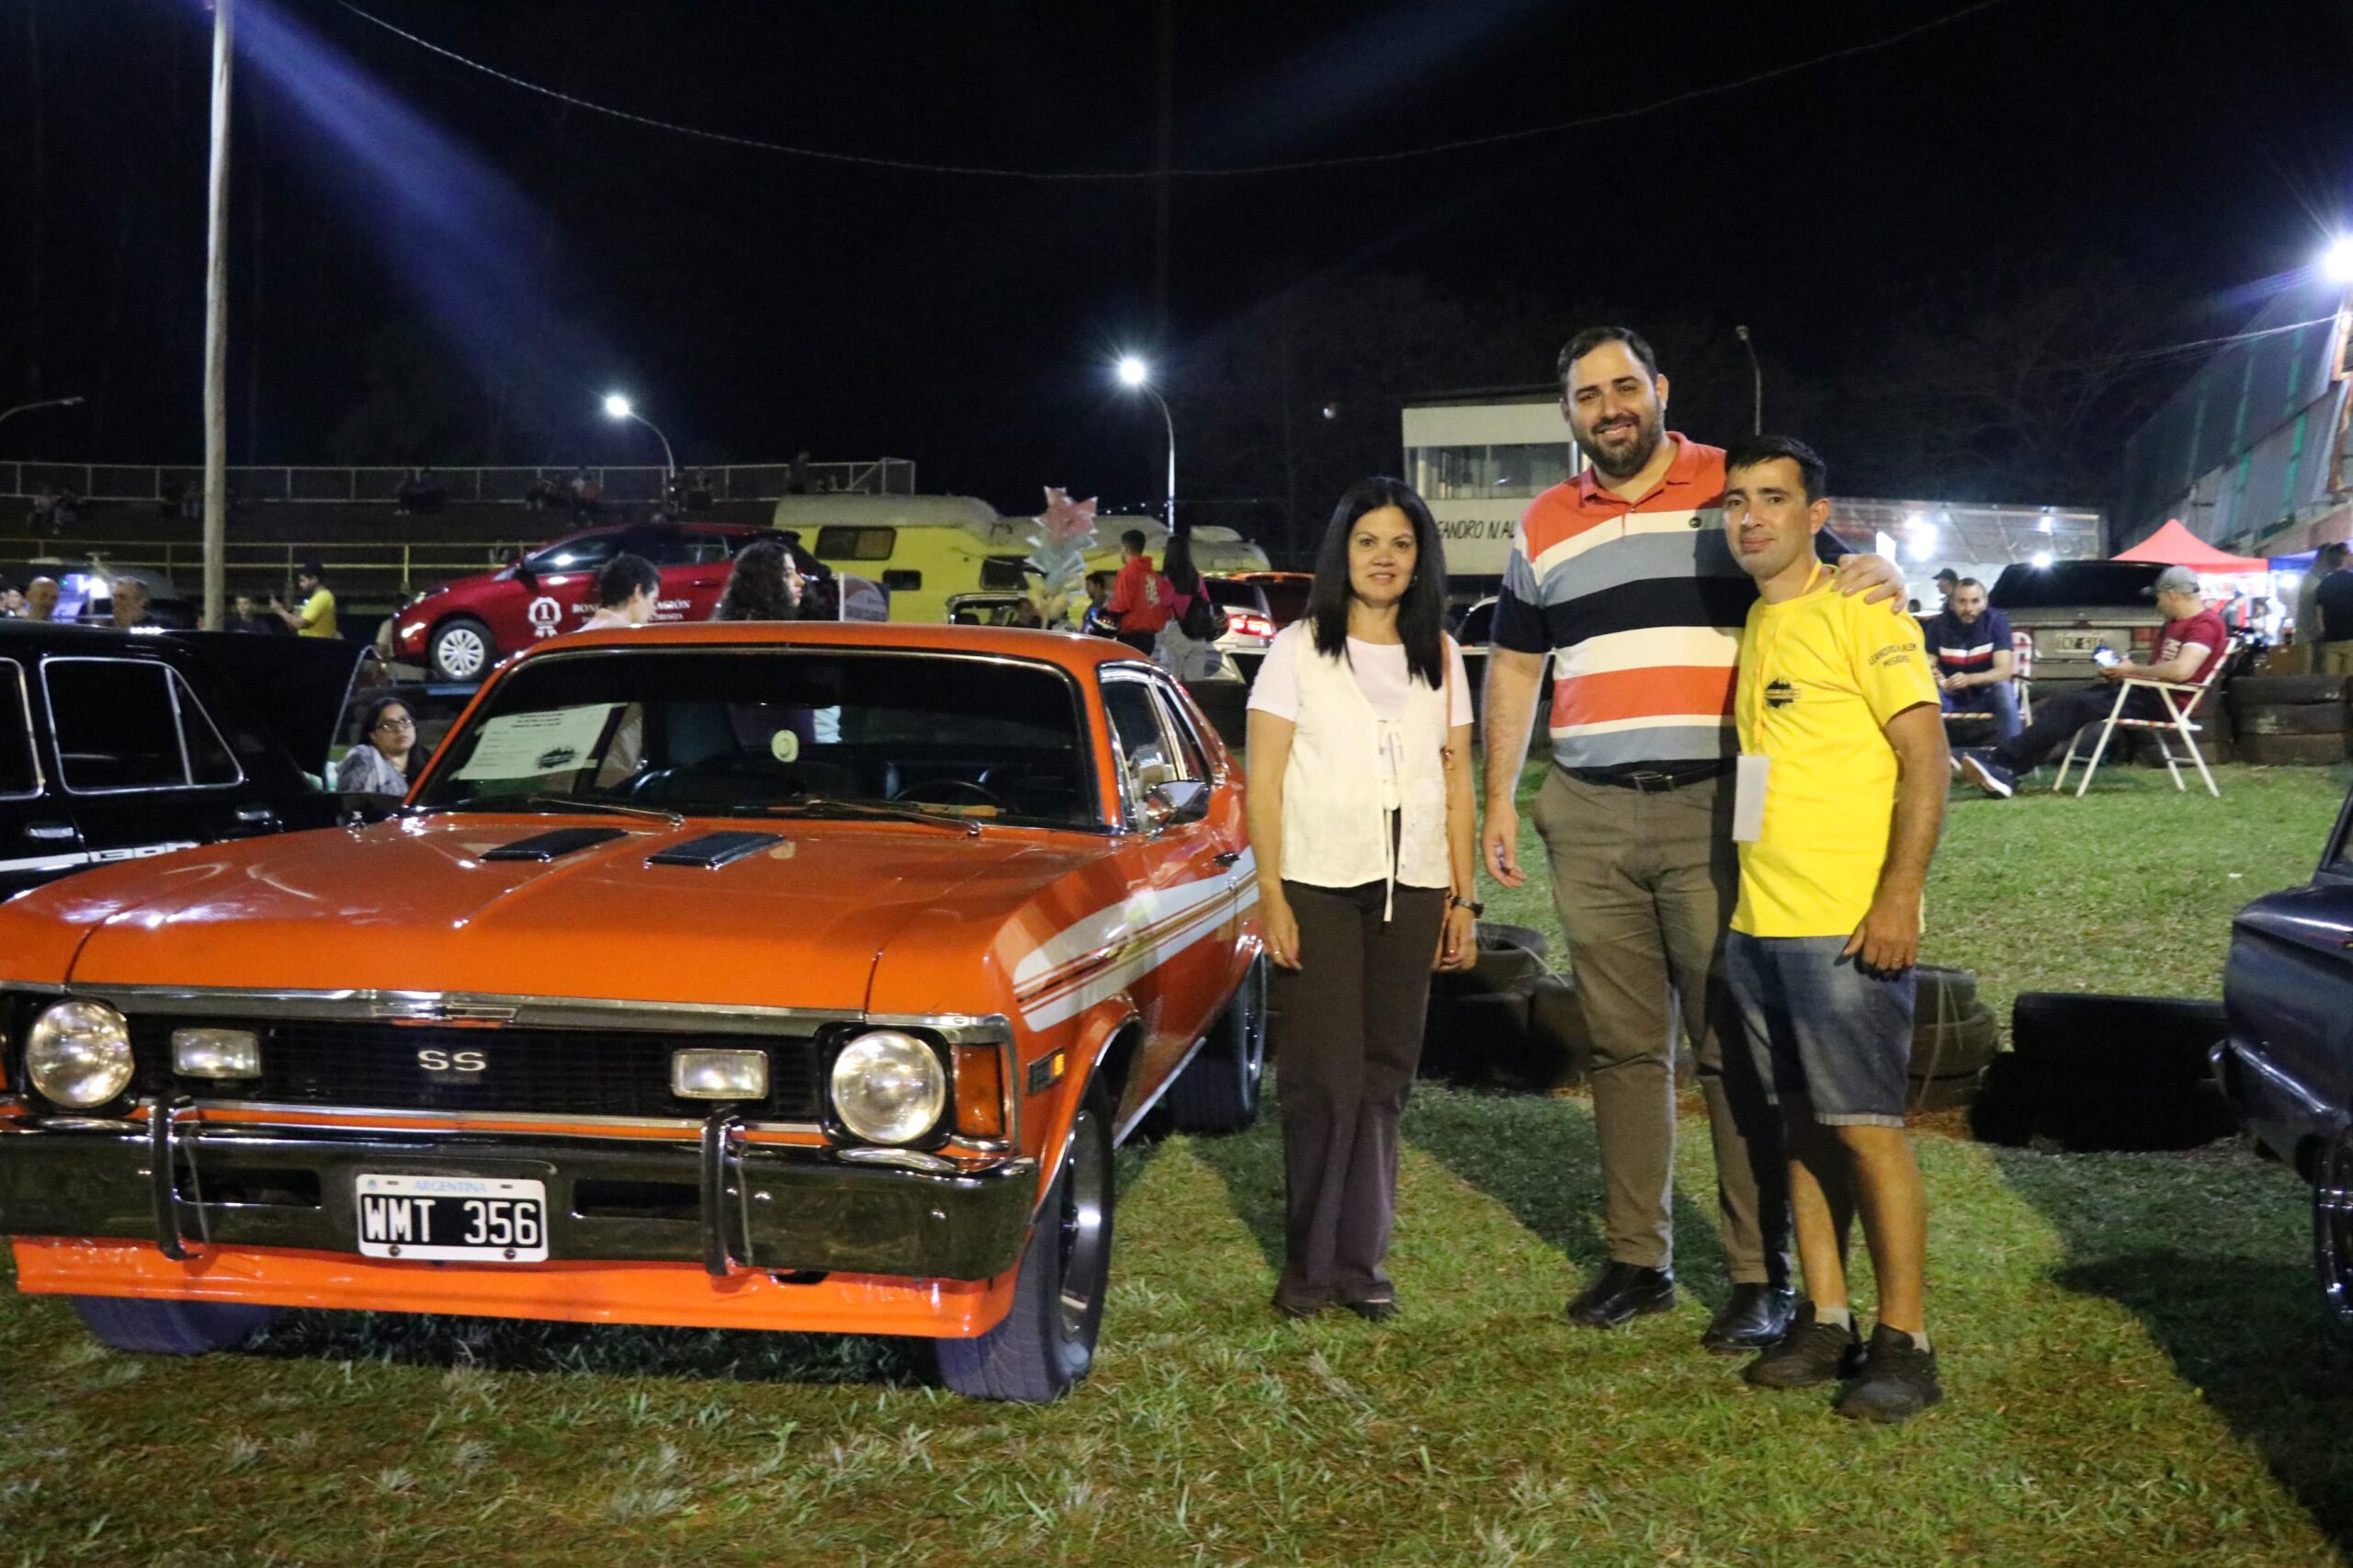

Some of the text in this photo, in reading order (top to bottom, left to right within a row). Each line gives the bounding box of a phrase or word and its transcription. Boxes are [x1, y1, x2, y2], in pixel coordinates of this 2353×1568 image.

[1436, 520, 1485, 540] EANDRO
[1501, 520, 1516, 540] AL
[417, 1050, 486, 1072] SS
[415, 1179, 487, 1193] ARGENTINA
[363, 1197, 539, 1245] WMT 356
